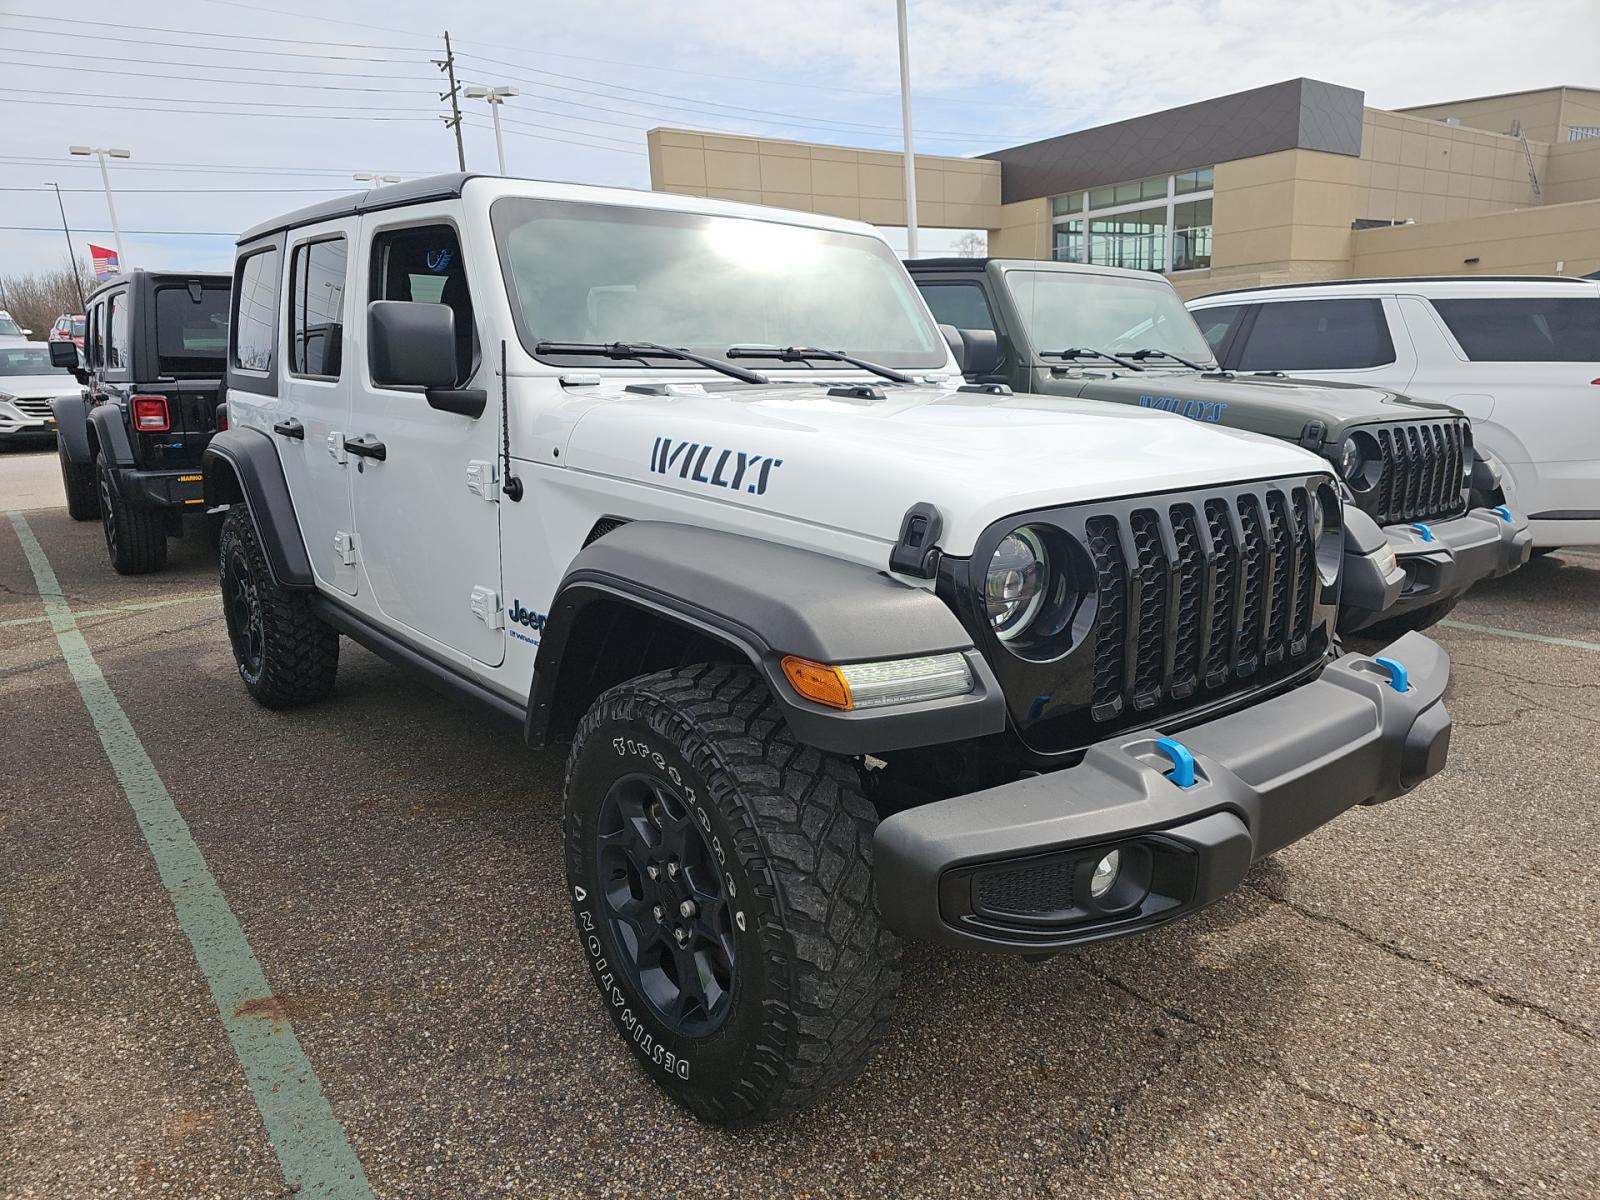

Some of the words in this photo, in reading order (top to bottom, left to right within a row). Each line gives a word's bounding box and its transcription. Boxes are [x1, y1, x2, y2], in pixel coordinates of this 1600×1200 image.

[650, 436, 783, 495] WILLYS
[508, 599, 547, 631] Jeep
[580, 911, 690, 1081] DESTINATION
